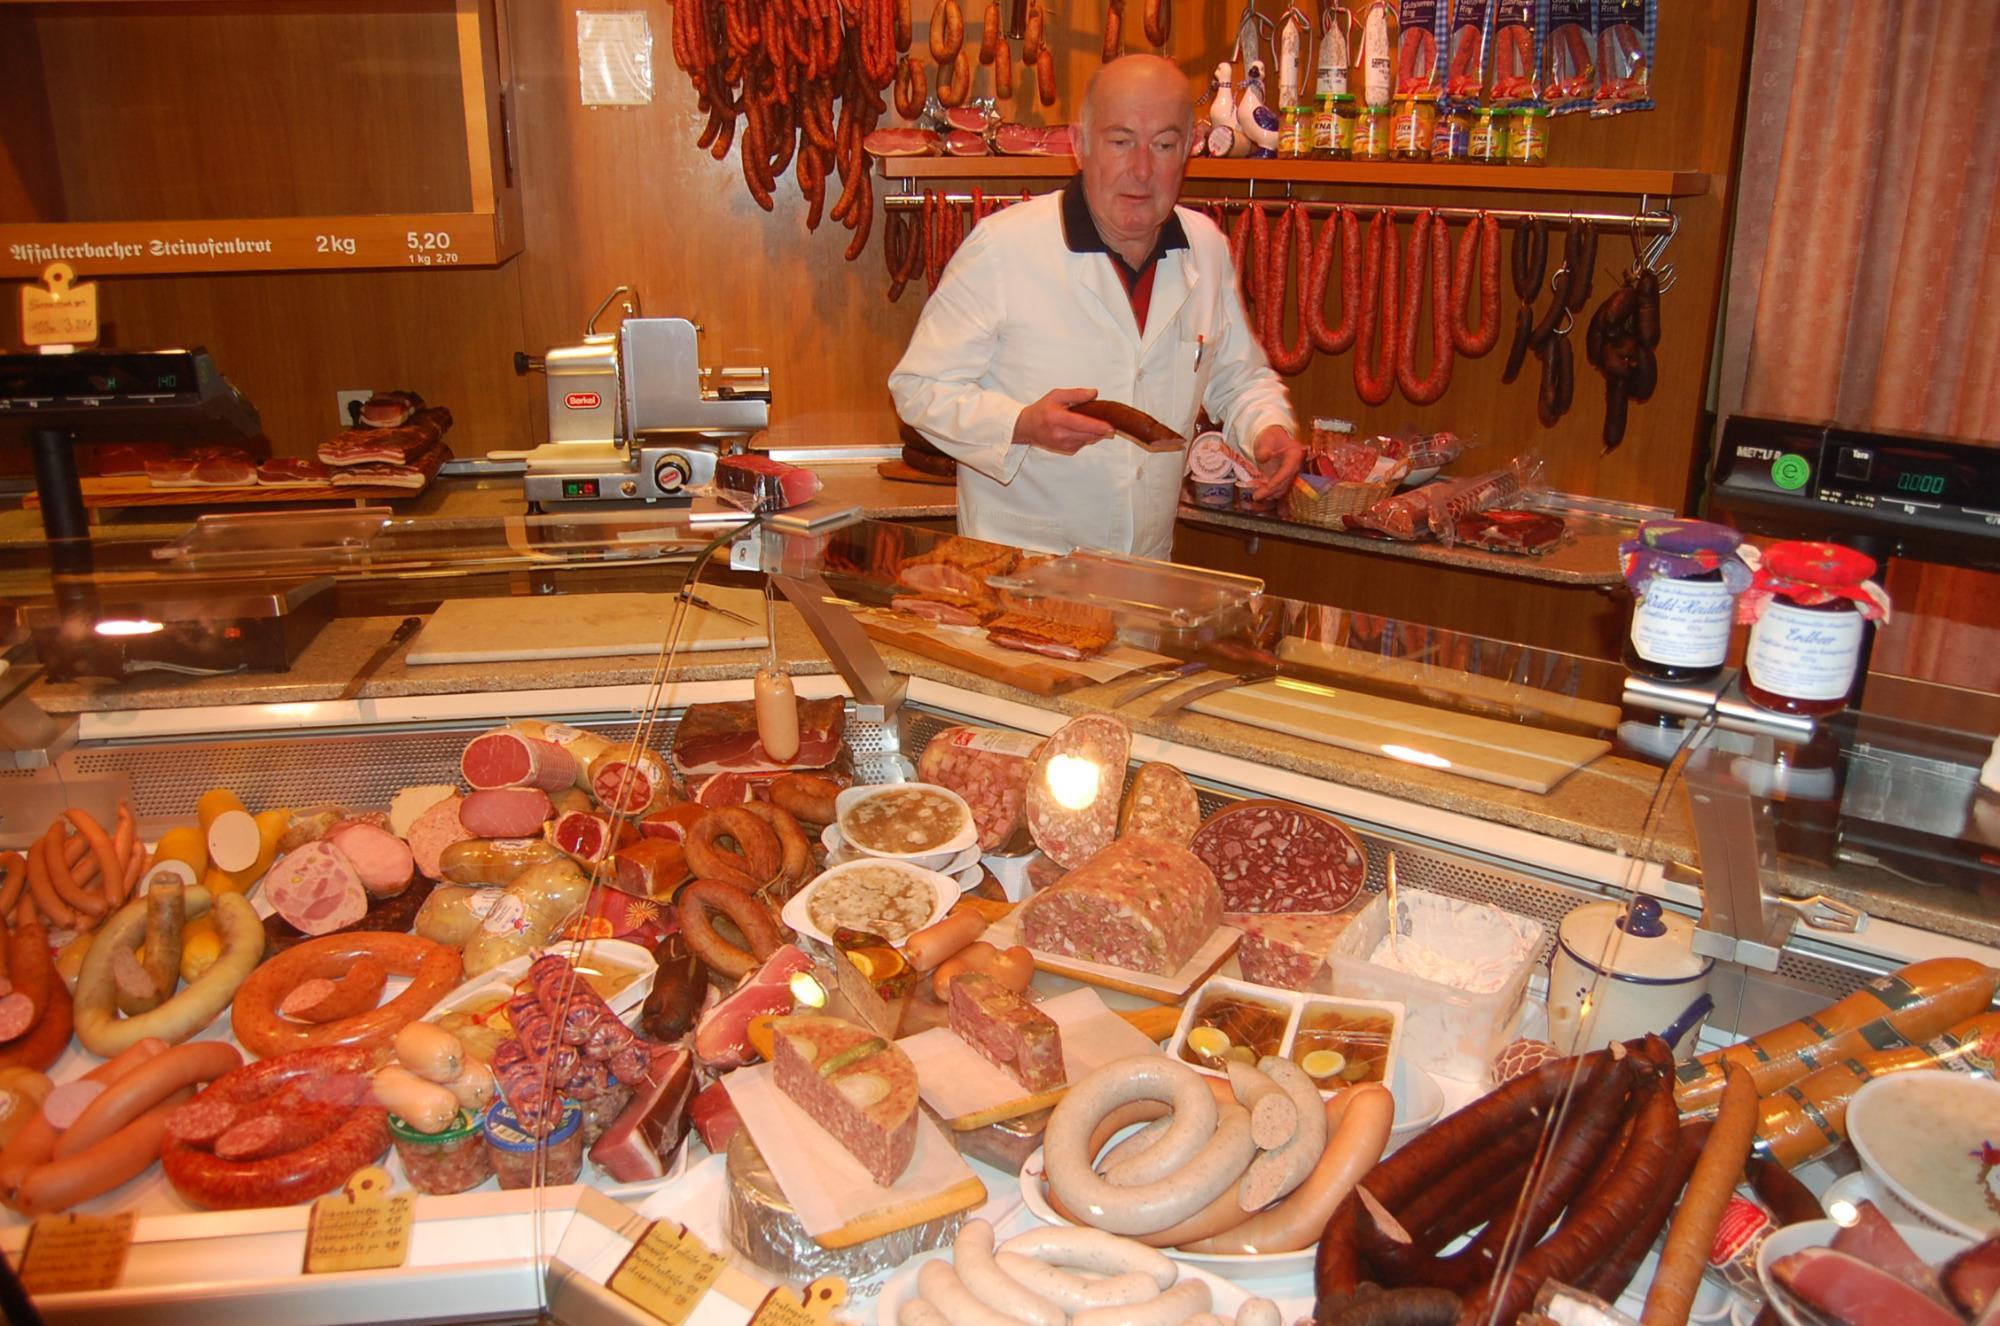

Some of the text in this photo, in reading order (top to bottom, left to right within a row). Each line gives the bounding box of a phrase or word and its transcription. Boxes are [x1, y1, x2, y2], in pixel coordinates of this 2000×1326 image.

[1551, 4, 1570, 14] Ring
[1601, 4, 1619, 14] Ring
[10, 241, 143, 264] Affalterbacher
[149, 238, 272, 258] Steinofenbrot
[407, 232, 450, 252] 5,20
[409, 253, 458, 265] 1 kg 2,70
[569, 396, 596, 405] Berkel
